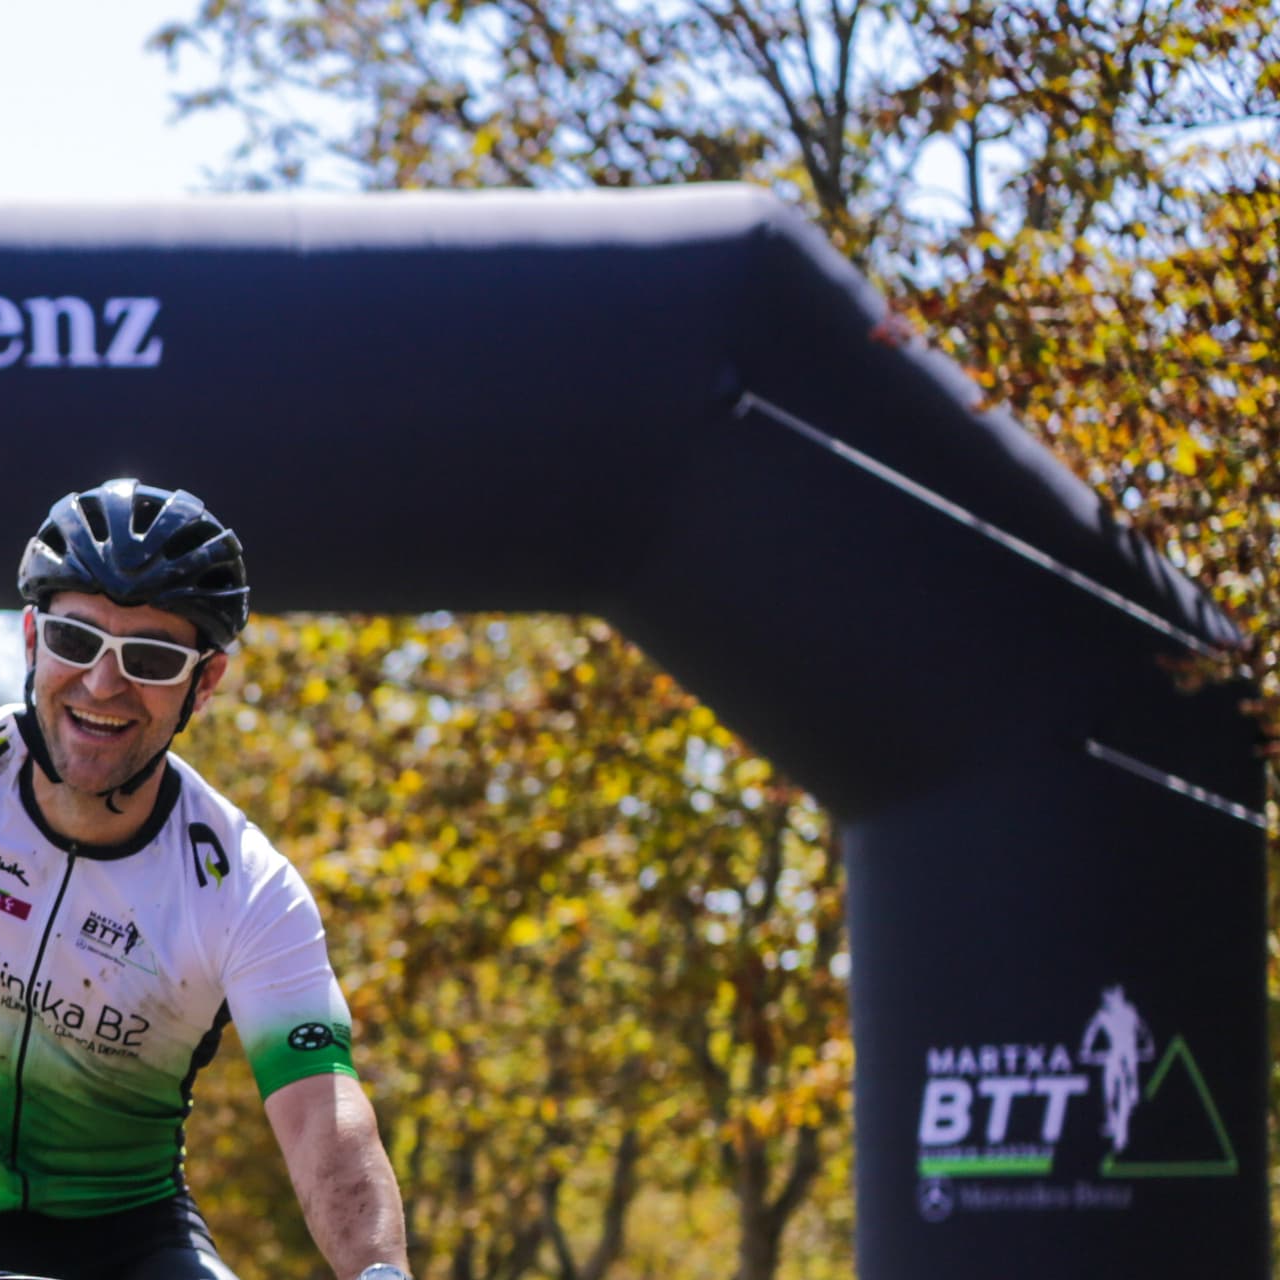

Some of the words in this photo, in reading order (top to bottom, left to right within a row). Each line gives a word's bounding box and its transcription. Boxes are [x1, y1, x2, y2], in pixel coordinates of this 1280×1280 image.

[81, 917, 125, 945] BTT
[95, 1004, 150, 1047] B2
[926, 1044, 1073, 1075] MARTXA
[918, 1076, 1090, 1145] BTT
